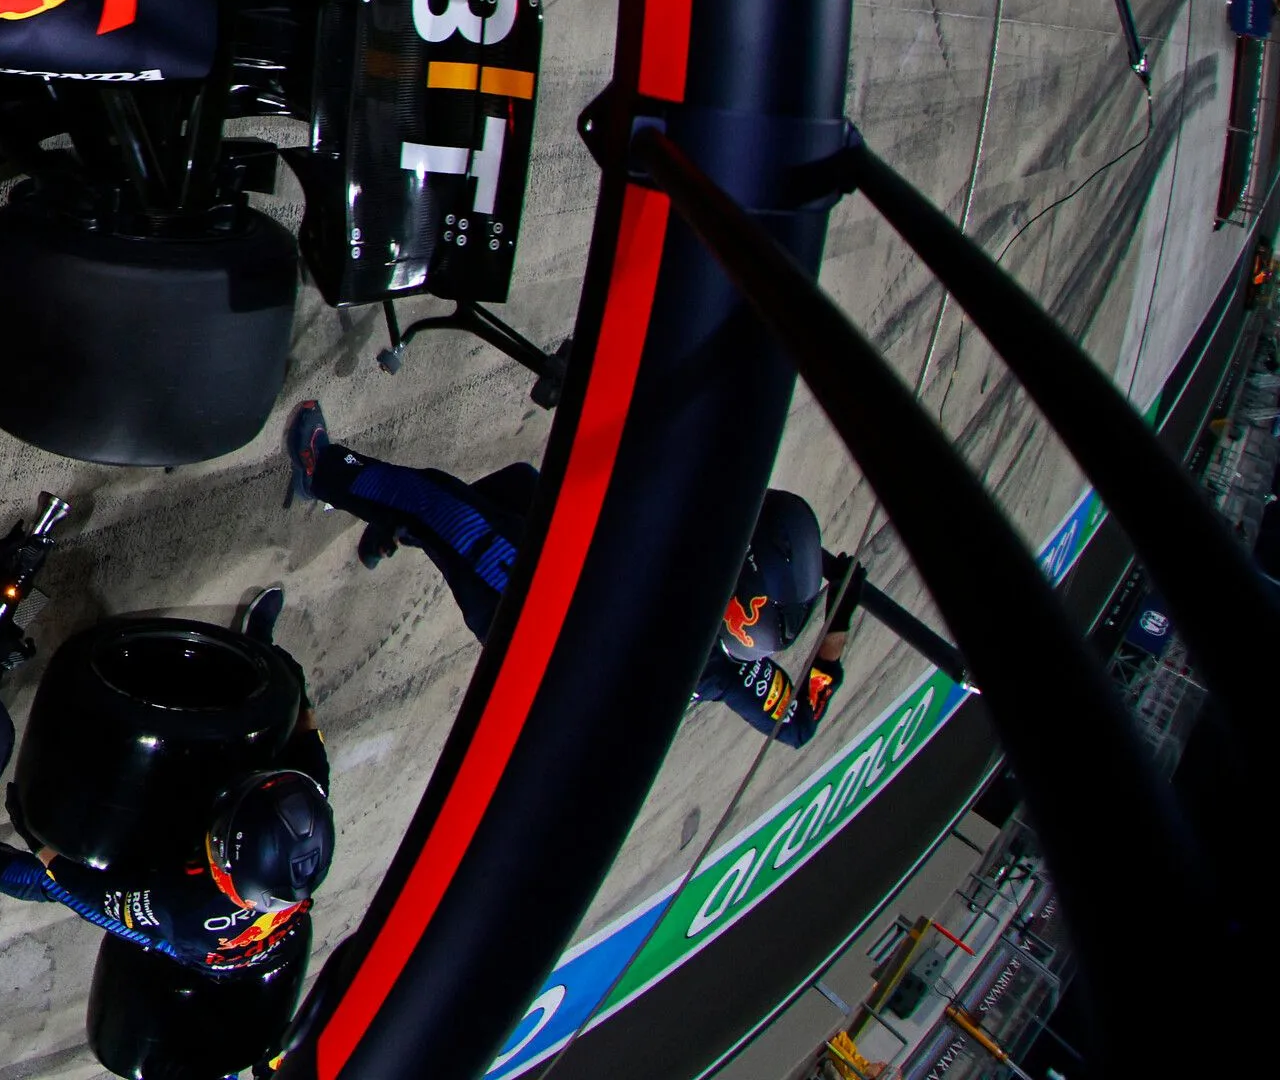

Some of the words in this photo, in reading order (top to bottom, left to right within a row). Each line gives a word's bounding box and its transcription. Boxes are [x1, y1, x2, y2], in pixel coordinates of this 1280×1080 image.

[686, 685, 936, 939] aramco
[132, 891, 152, 927] ROKT
[979, 964, 1016, 1012] AIRWAYS
